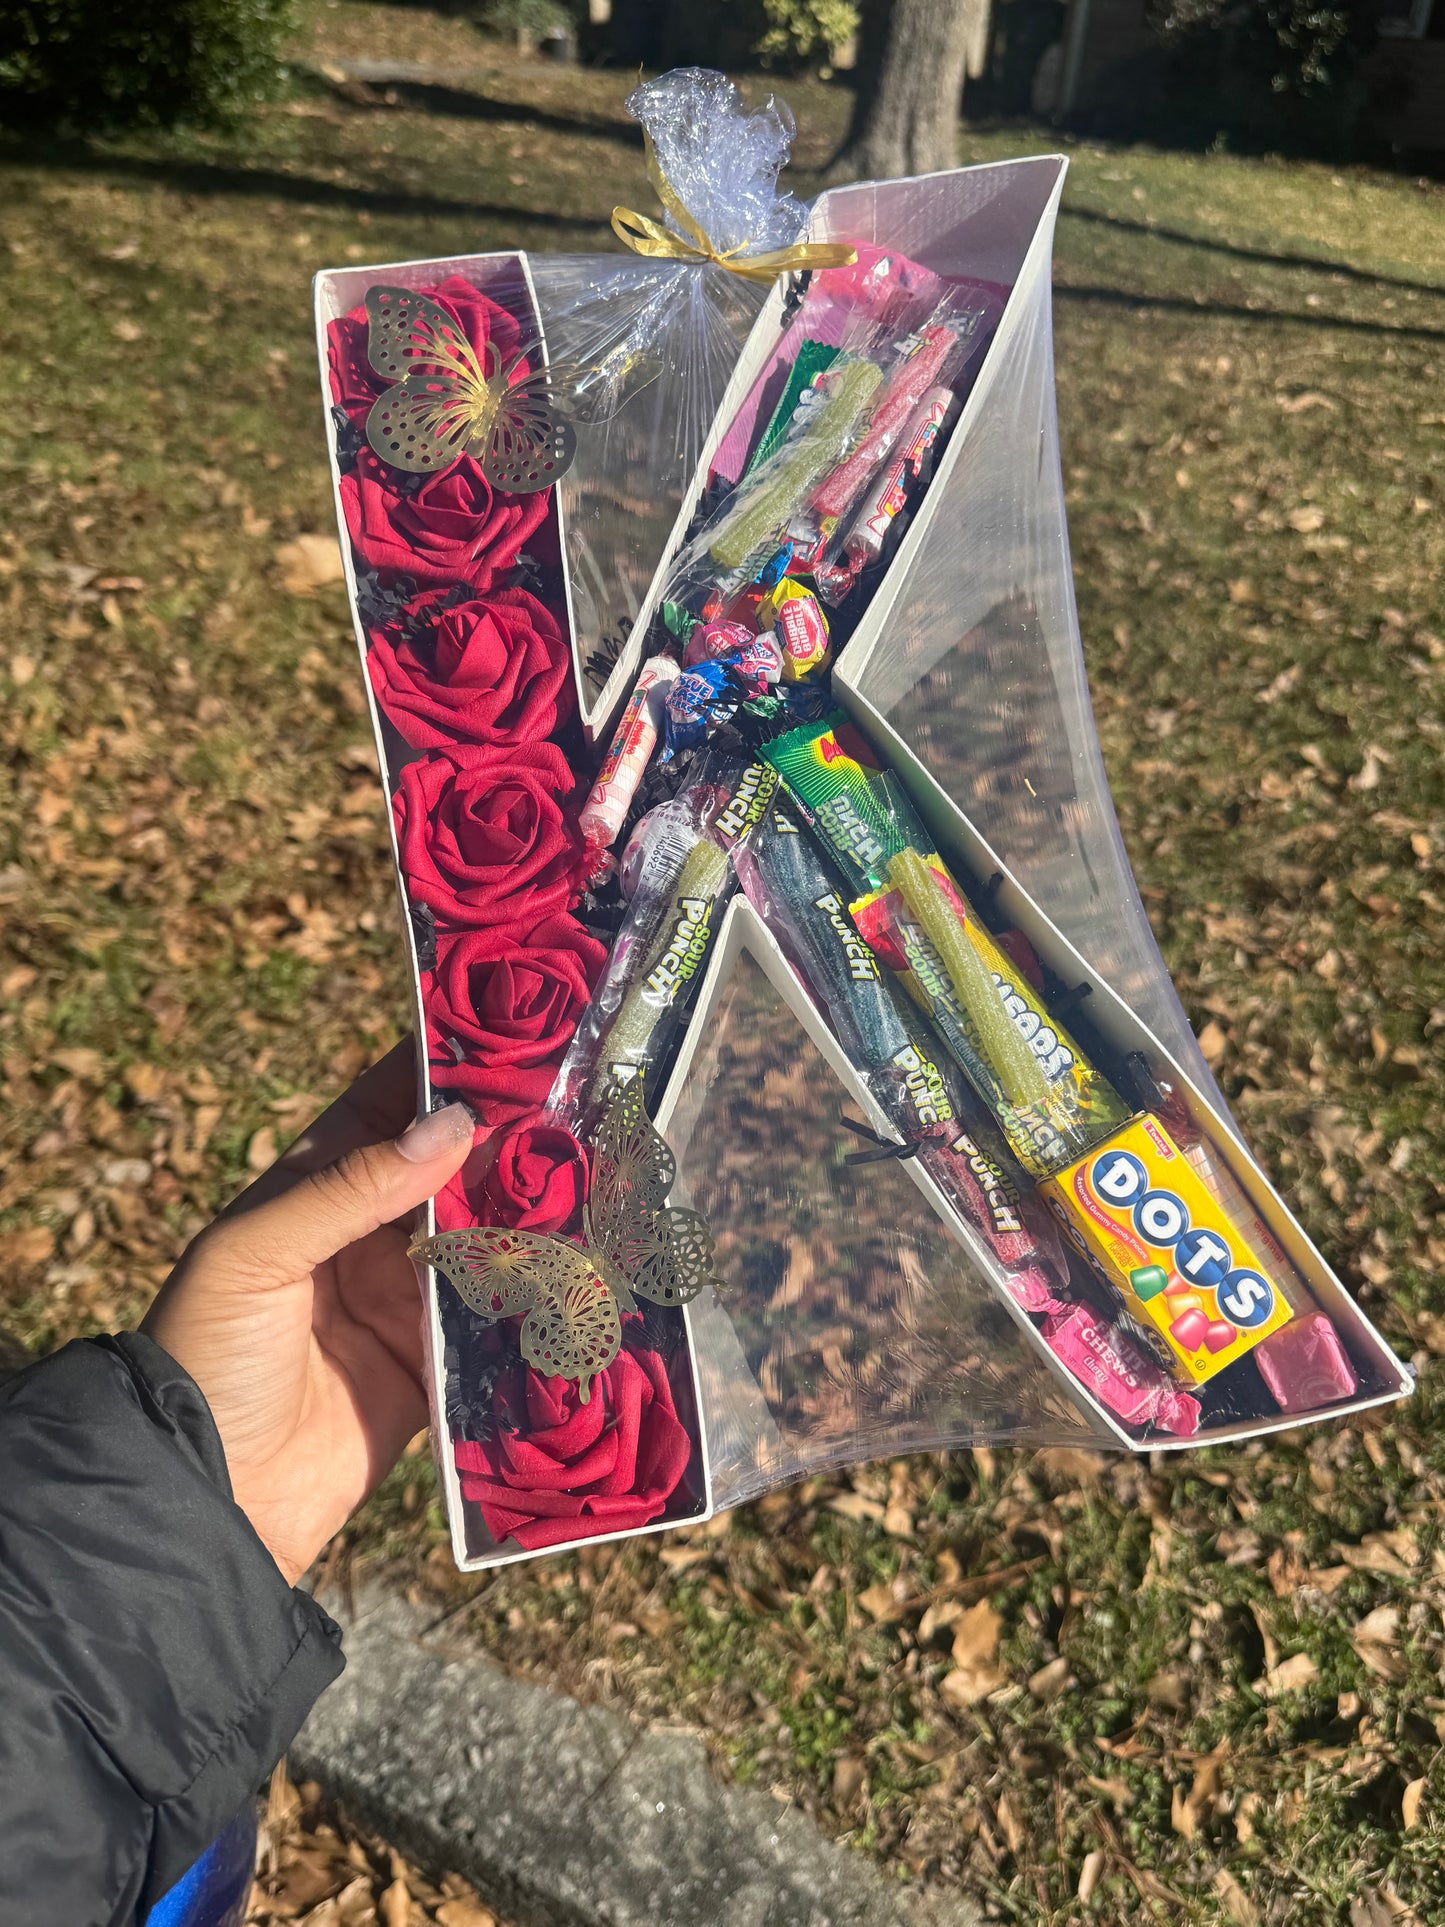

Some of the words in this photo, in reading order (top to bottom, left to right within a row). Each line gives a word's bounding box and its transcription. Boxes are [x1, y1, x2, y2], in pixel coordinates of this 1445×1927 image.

[783, 605, 803, 655] DUBBLE
[794, 605, 812, 653] BUBBLE
[714, 763, 763, 838] UNCH
[747, 768, 778, 825] SOUR
[649, 835, 671, 869] 140692
[646, 899, 706, 993] PUNCH
[675, 923, 711, 981] SOUR
[815, 893, 875, 981] PUNCH
[893, 1045, 937, 1126] PUNC
[920, 1060, 953, 1122] SOUR
[1147, 1126, 1170, 1155] Tootsie
[952, 1134, 1022, 1231] PUNCH
[980, 1151, 1020, 1205] SOUR
[1076, 1175, 1096, 1208] Assorted
[1089, 1205, 1113, 1229] Gummy
[1111, 1222, 1131, 1246] Candy
[1125, 1234, 1149, 1261] Pieces
[1097, 1156, 1269, 1319] DOTS
[1080, 1327, 1138, 1388] CHEWS
[1083, 1355, 1110, 1384] Cherry
